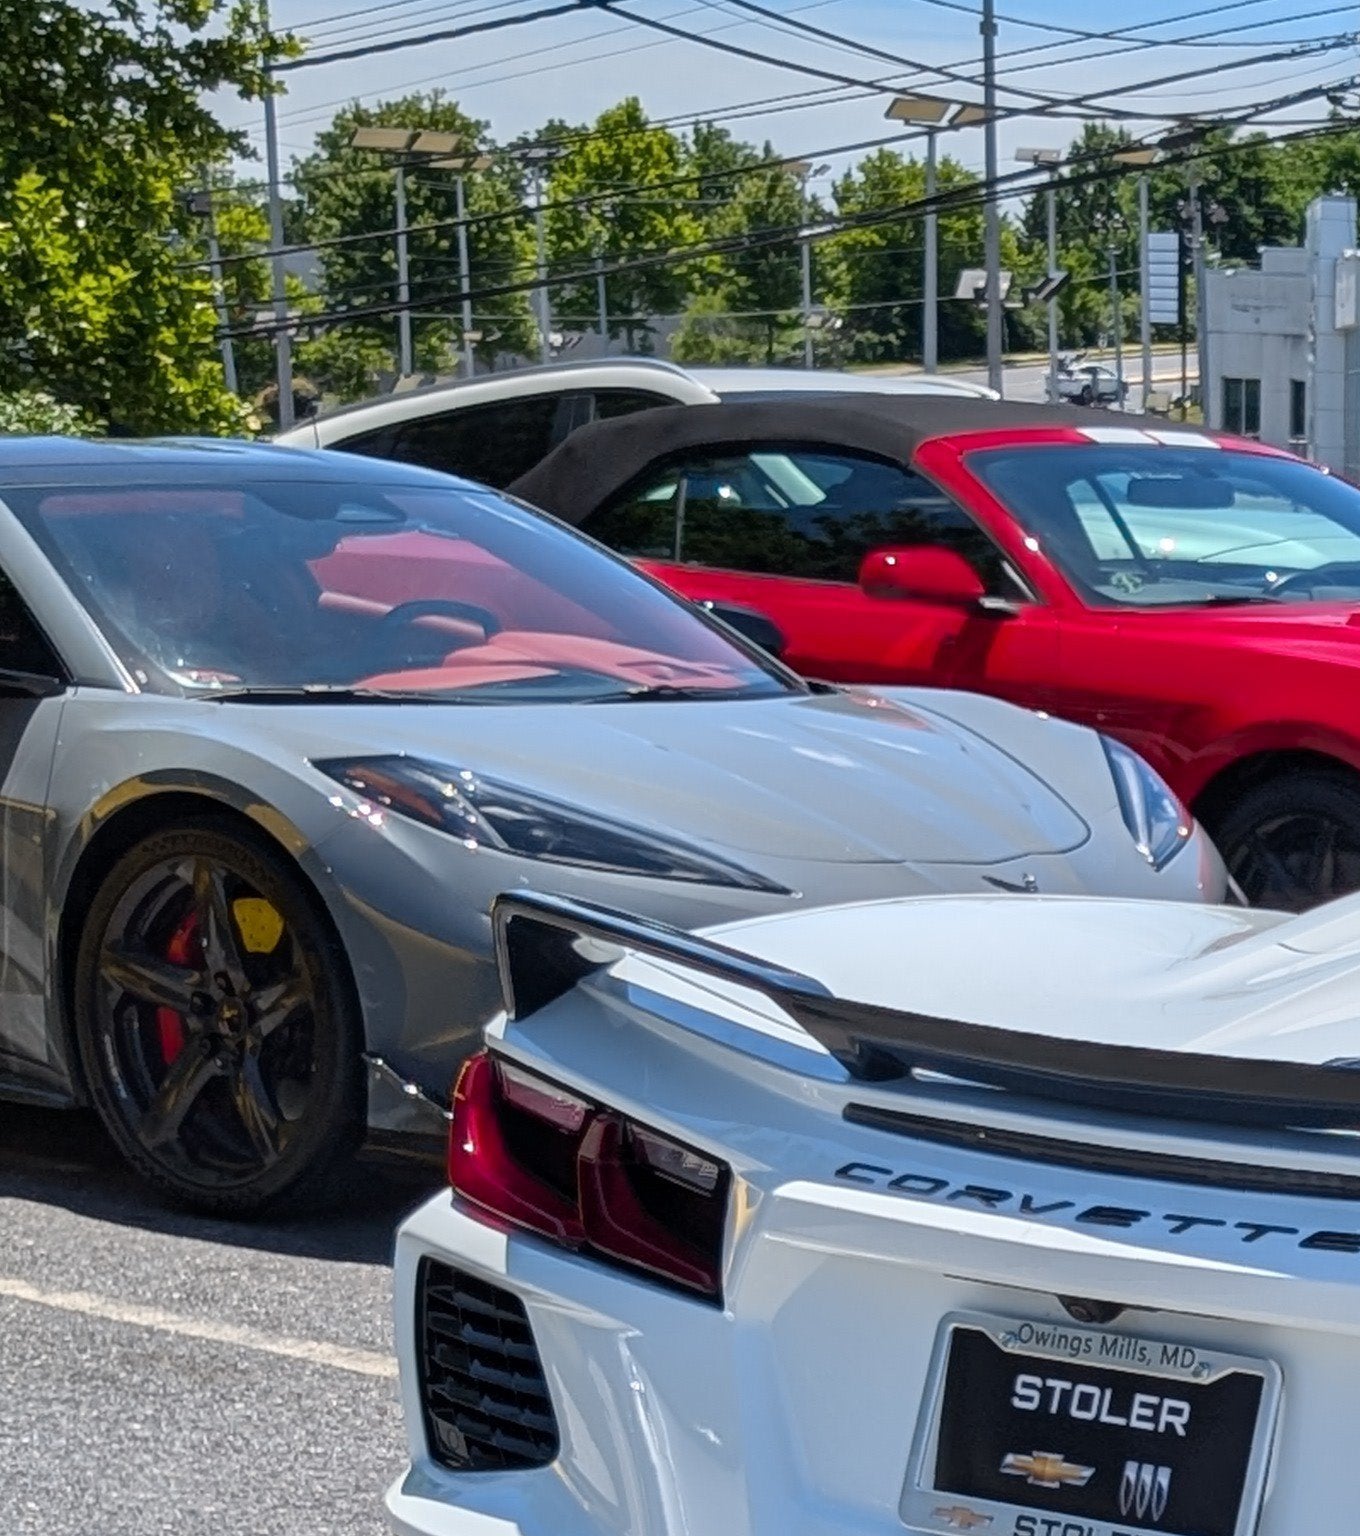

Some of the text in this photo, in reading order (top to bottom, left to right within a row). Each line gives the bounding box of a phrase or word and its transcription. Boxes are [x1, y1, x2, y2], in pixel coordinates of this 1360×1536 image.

[1017, 1322, 1196, 1370] Owings Mills, MD
[1011, 1374, 1191, 1436] STOLER
